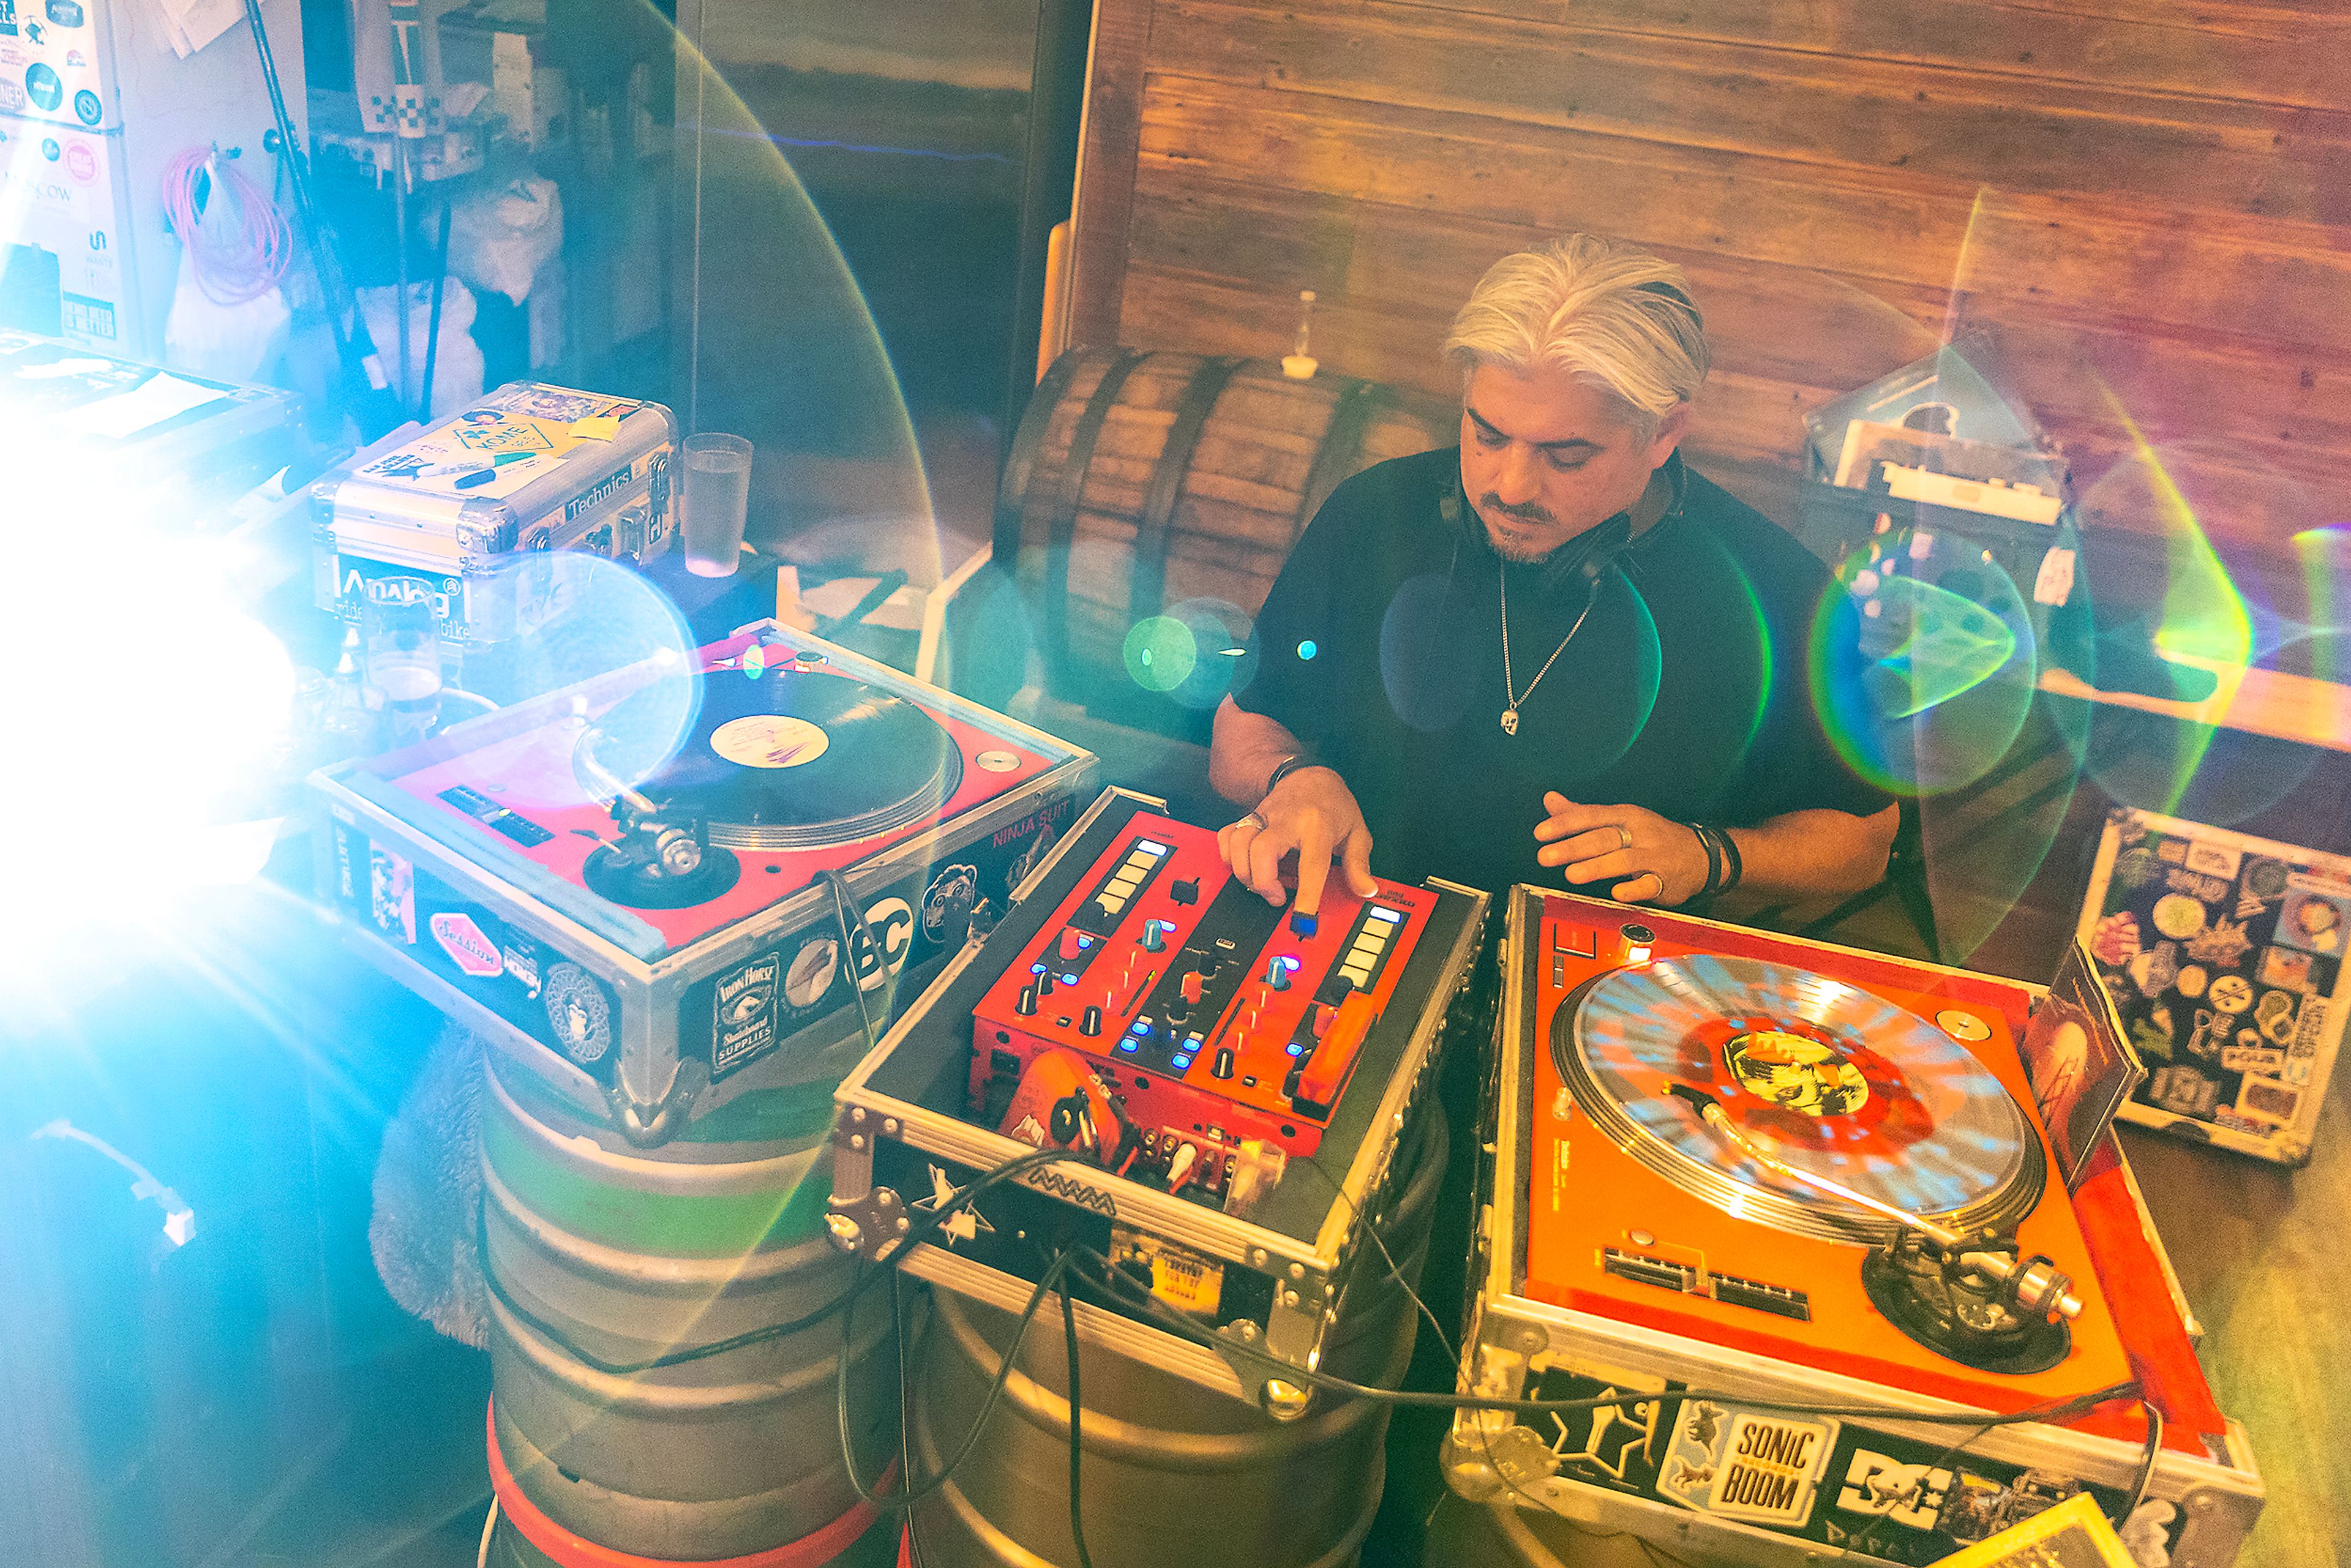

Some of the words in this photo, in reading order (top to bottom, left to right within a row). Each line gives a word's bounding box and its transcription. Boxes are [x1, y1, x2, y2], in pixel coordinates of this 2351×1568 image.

[569, 471, 629, 519] Technics
[992, 817, 1035, 849] NINJA
[1038, 801, 1069, 827] SUIT
[438, 920, 495, 966] Session
[718, 1026, 771, 1060] SUPPLIES
[1720, 1463, 1799, 1510] BOOM
